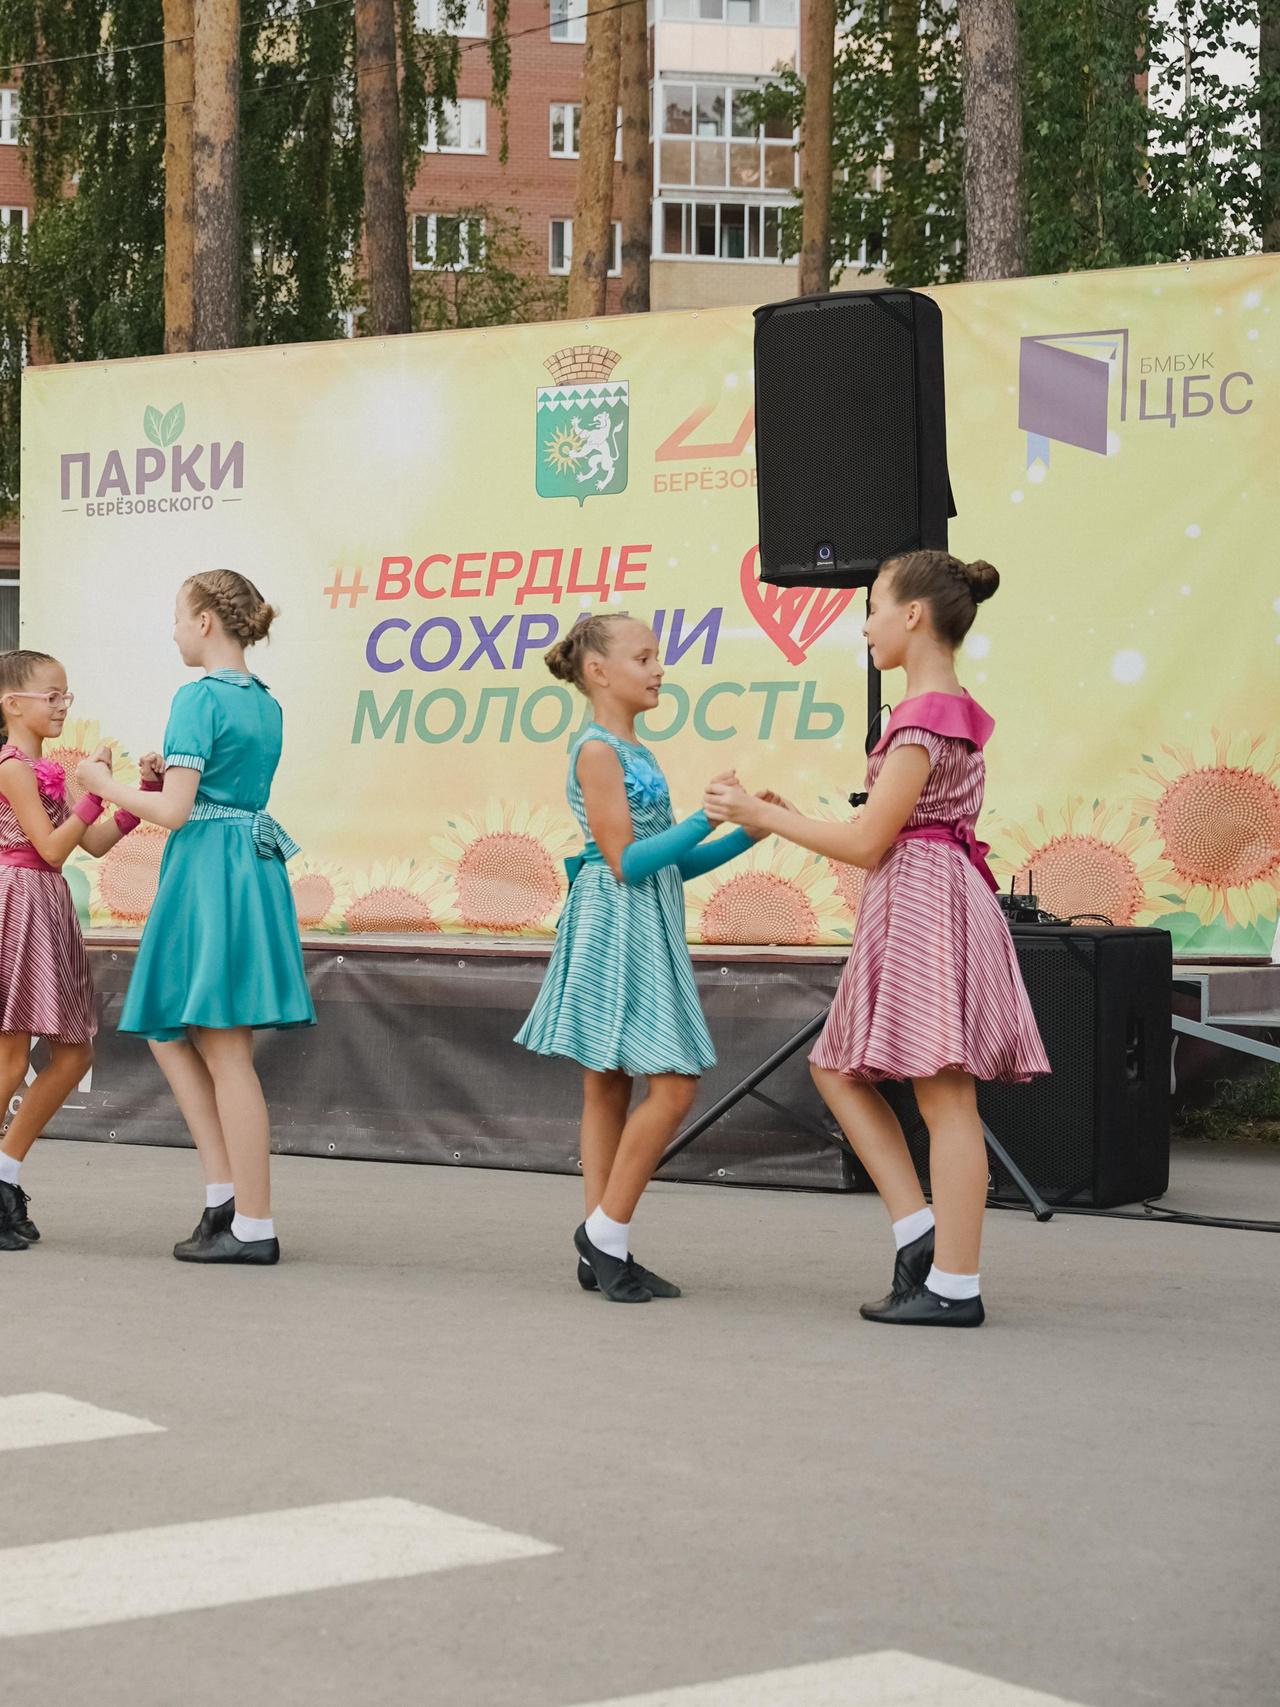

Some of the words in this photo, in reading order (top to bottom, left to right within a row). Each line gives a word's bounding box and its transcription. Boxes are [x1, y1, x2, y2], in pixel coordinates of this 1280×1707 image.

[1140, 351, 1215, 374] БМБУК
[1139, 372, 1253, 428] ЦБС
[61, 441, 244, 500] ПАРКИ
[85, 495, 214, 517] БЕРЁЗОВСКОГО
[323, 544, 653, 609] #ВСЕРДЦЕ
[365, 607, 724, 674] СОХРИ
[350, 680, 845, 755] МОЛООСТЬ
